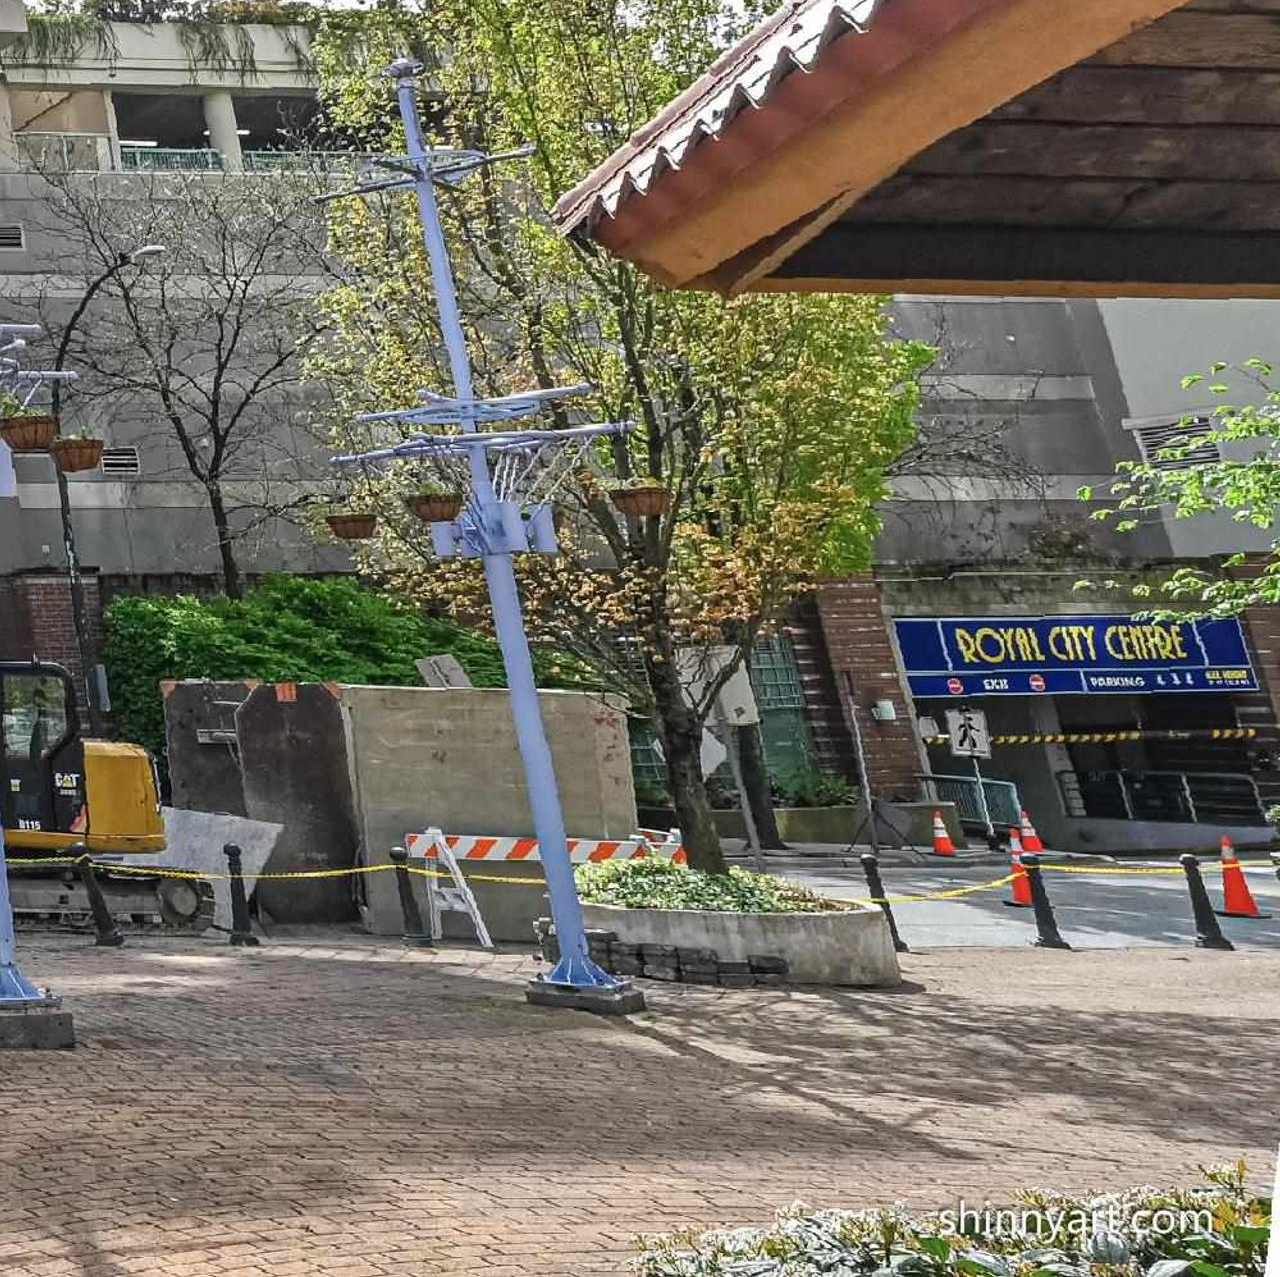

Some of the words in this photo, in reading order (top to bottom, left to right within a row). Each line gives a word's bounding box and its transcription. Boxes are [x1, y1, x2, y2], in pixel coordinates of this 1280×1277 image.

[955, 626, 1045, 663] ROYAL
[1049, 625, 1097, 661] CITY
[1104, 624, 1188, 660] CENTRE
[983, 678, 1009, 690] EXIT
[1090, 677, 1146, 687] PARKING
[55, 773, 81, 787] CAT
